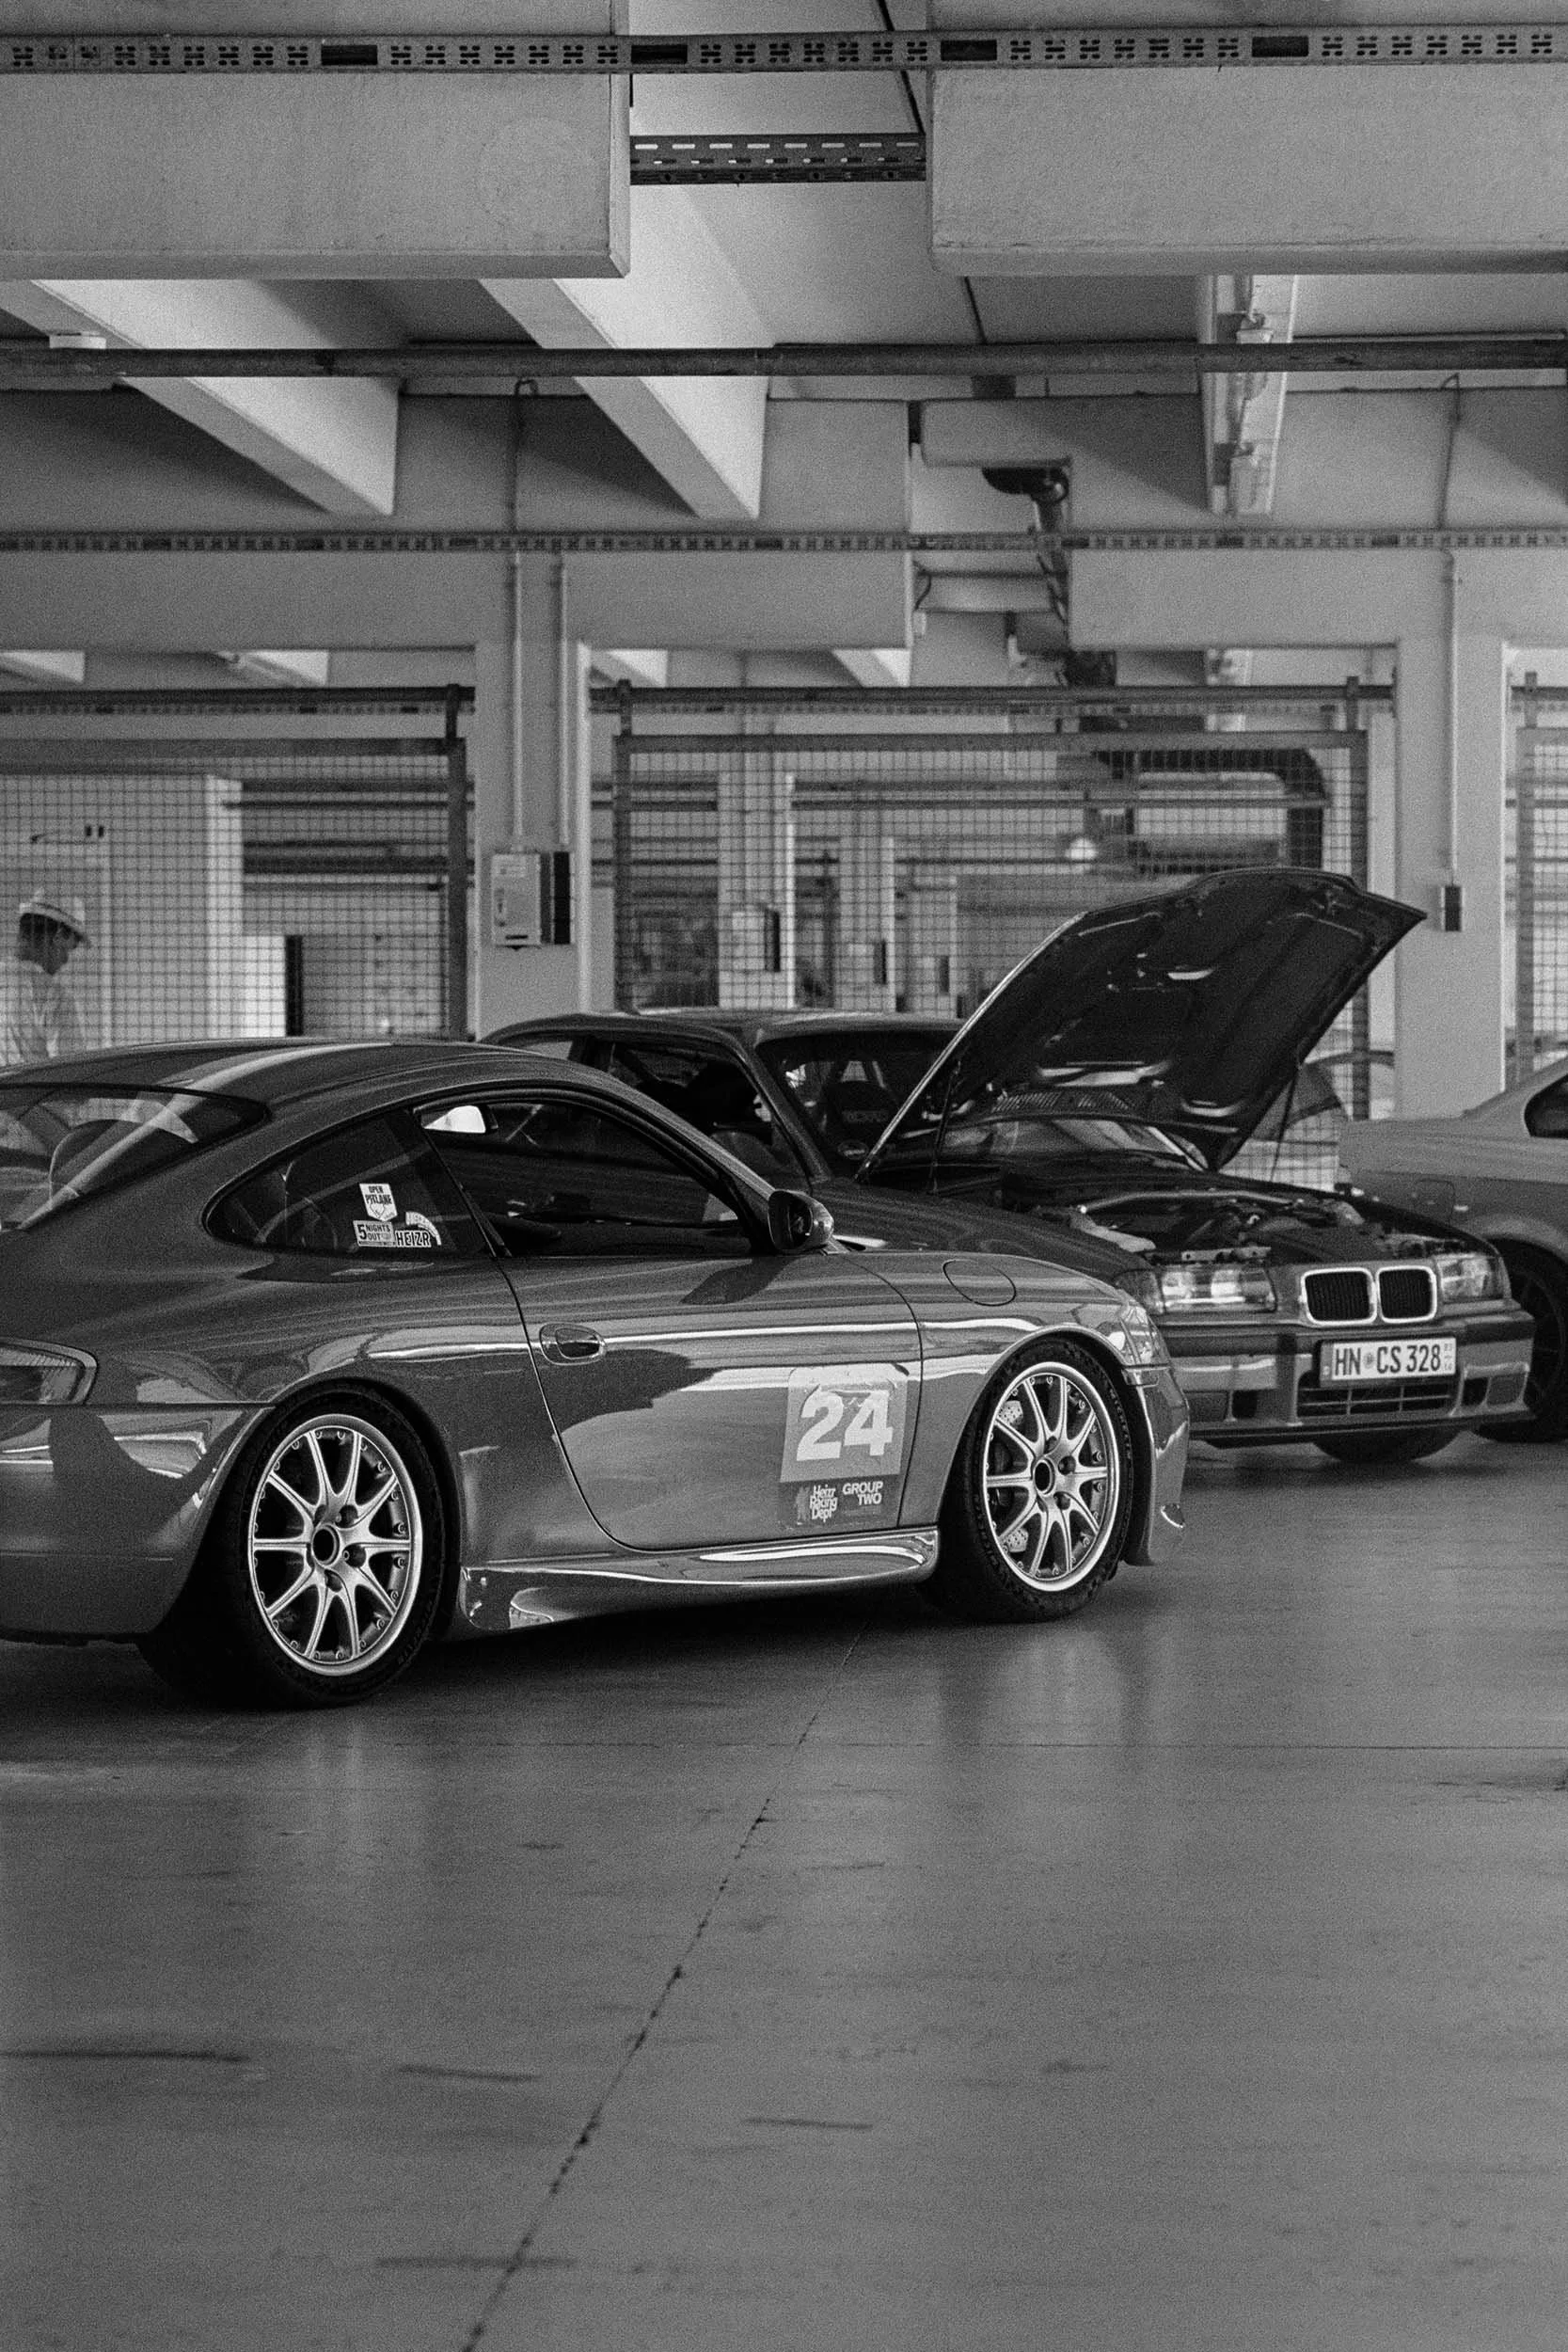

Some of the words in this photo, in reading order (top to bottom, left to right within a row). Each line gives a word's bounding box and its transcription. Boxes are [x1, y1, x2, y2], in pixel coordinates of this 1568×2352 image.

[368, 1185, 384, 1194] OPEN
[356, 1224, 367, 1240] 5
[366, 1224, 391, 1232] NIGHTS
[367, 1232, 381, 1241] OUT
[396, 1232, 430, 1247] HEIZR
[1335, 1347, 1361, 1376] HN
[1376, 1345, 1401, 1374] CS
[1406, 1343, 1441, 1373] 328
[797, 1388, 894, 1461] 24
[842, 1481, 883, 1495] GROUP
[810, 1496, 838, 1512] Racing
[858, 1492, 882, 1505] TWO
